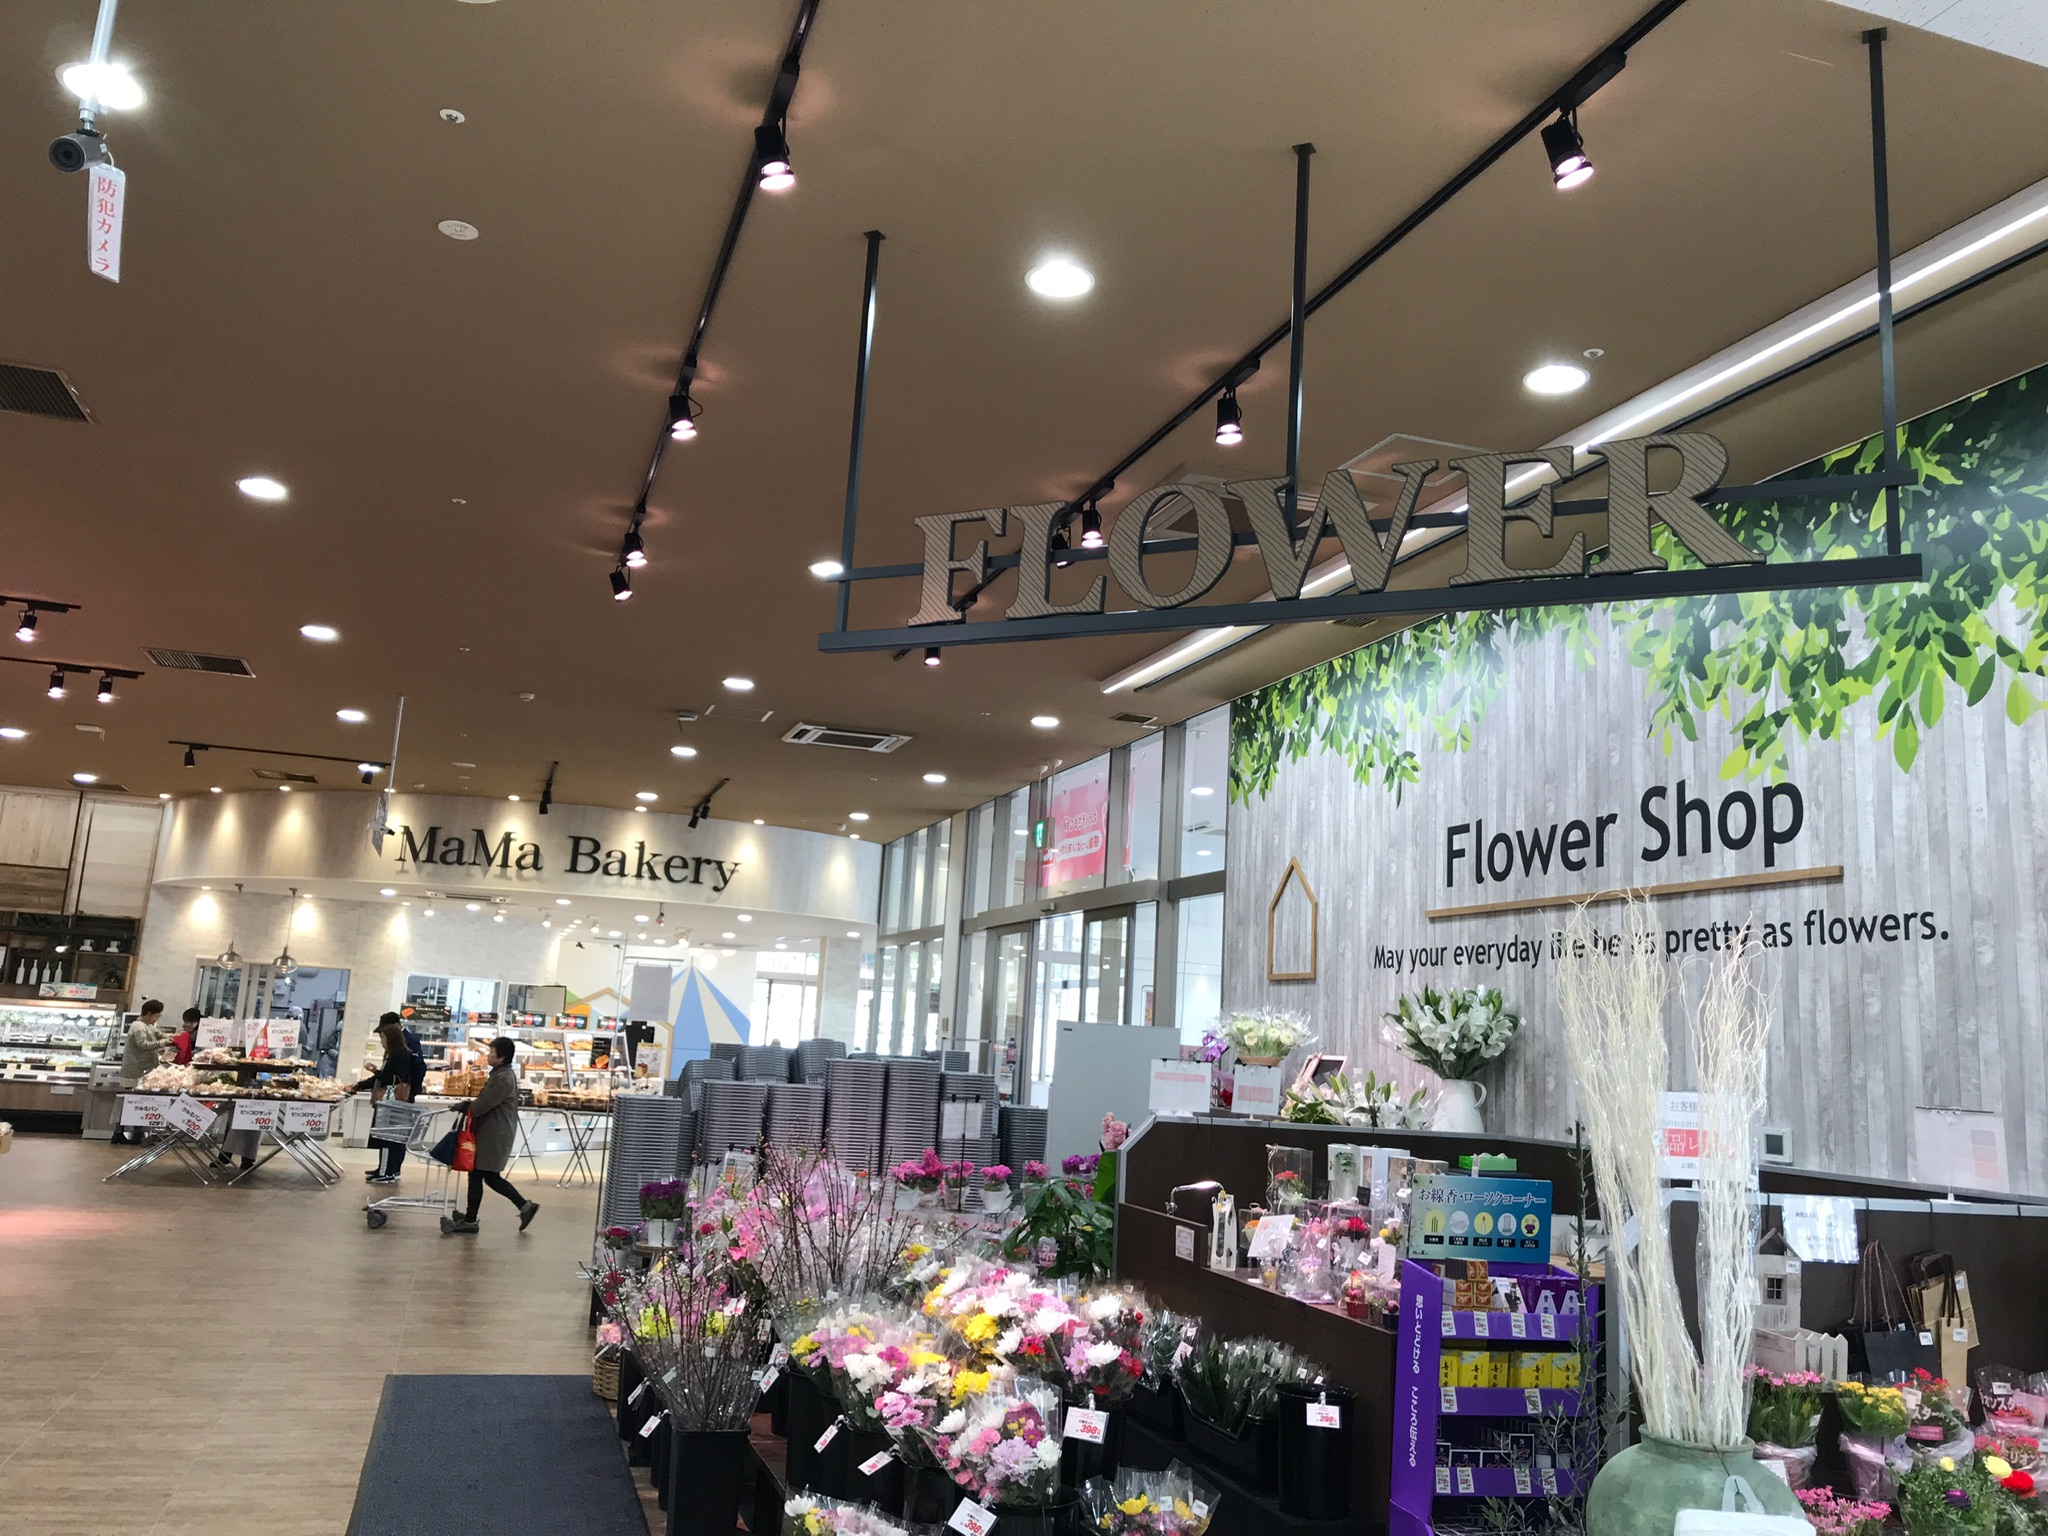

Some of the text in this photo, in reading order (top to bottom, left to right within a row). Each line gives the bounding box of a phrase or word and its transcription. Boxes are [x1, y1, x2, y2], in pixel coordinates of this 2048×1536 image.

[95, 176, 117, 272] 防犯カメラ
[908, 433, 1768, 627] FLOWER
[395, 825, 741, 892] MaMa Bakery
[1447, 779, 1802, 887] Flower Shop
[1374, 945, 1402, 974] May
[1409, 942, 1447, 974] your
[1453, 933, 1542, 970] everyday
[1665, 920, 1751, 962] pretty
[1762, 923, 1792, 949] as
[1805, 909, 1950, 946] flowers.
[1419, 1187, 1546, 1208] お線香・ローソクコーナー
[1080, 1424, 1098, 1434] 398
[965, 1519, 982, 1533] 398
